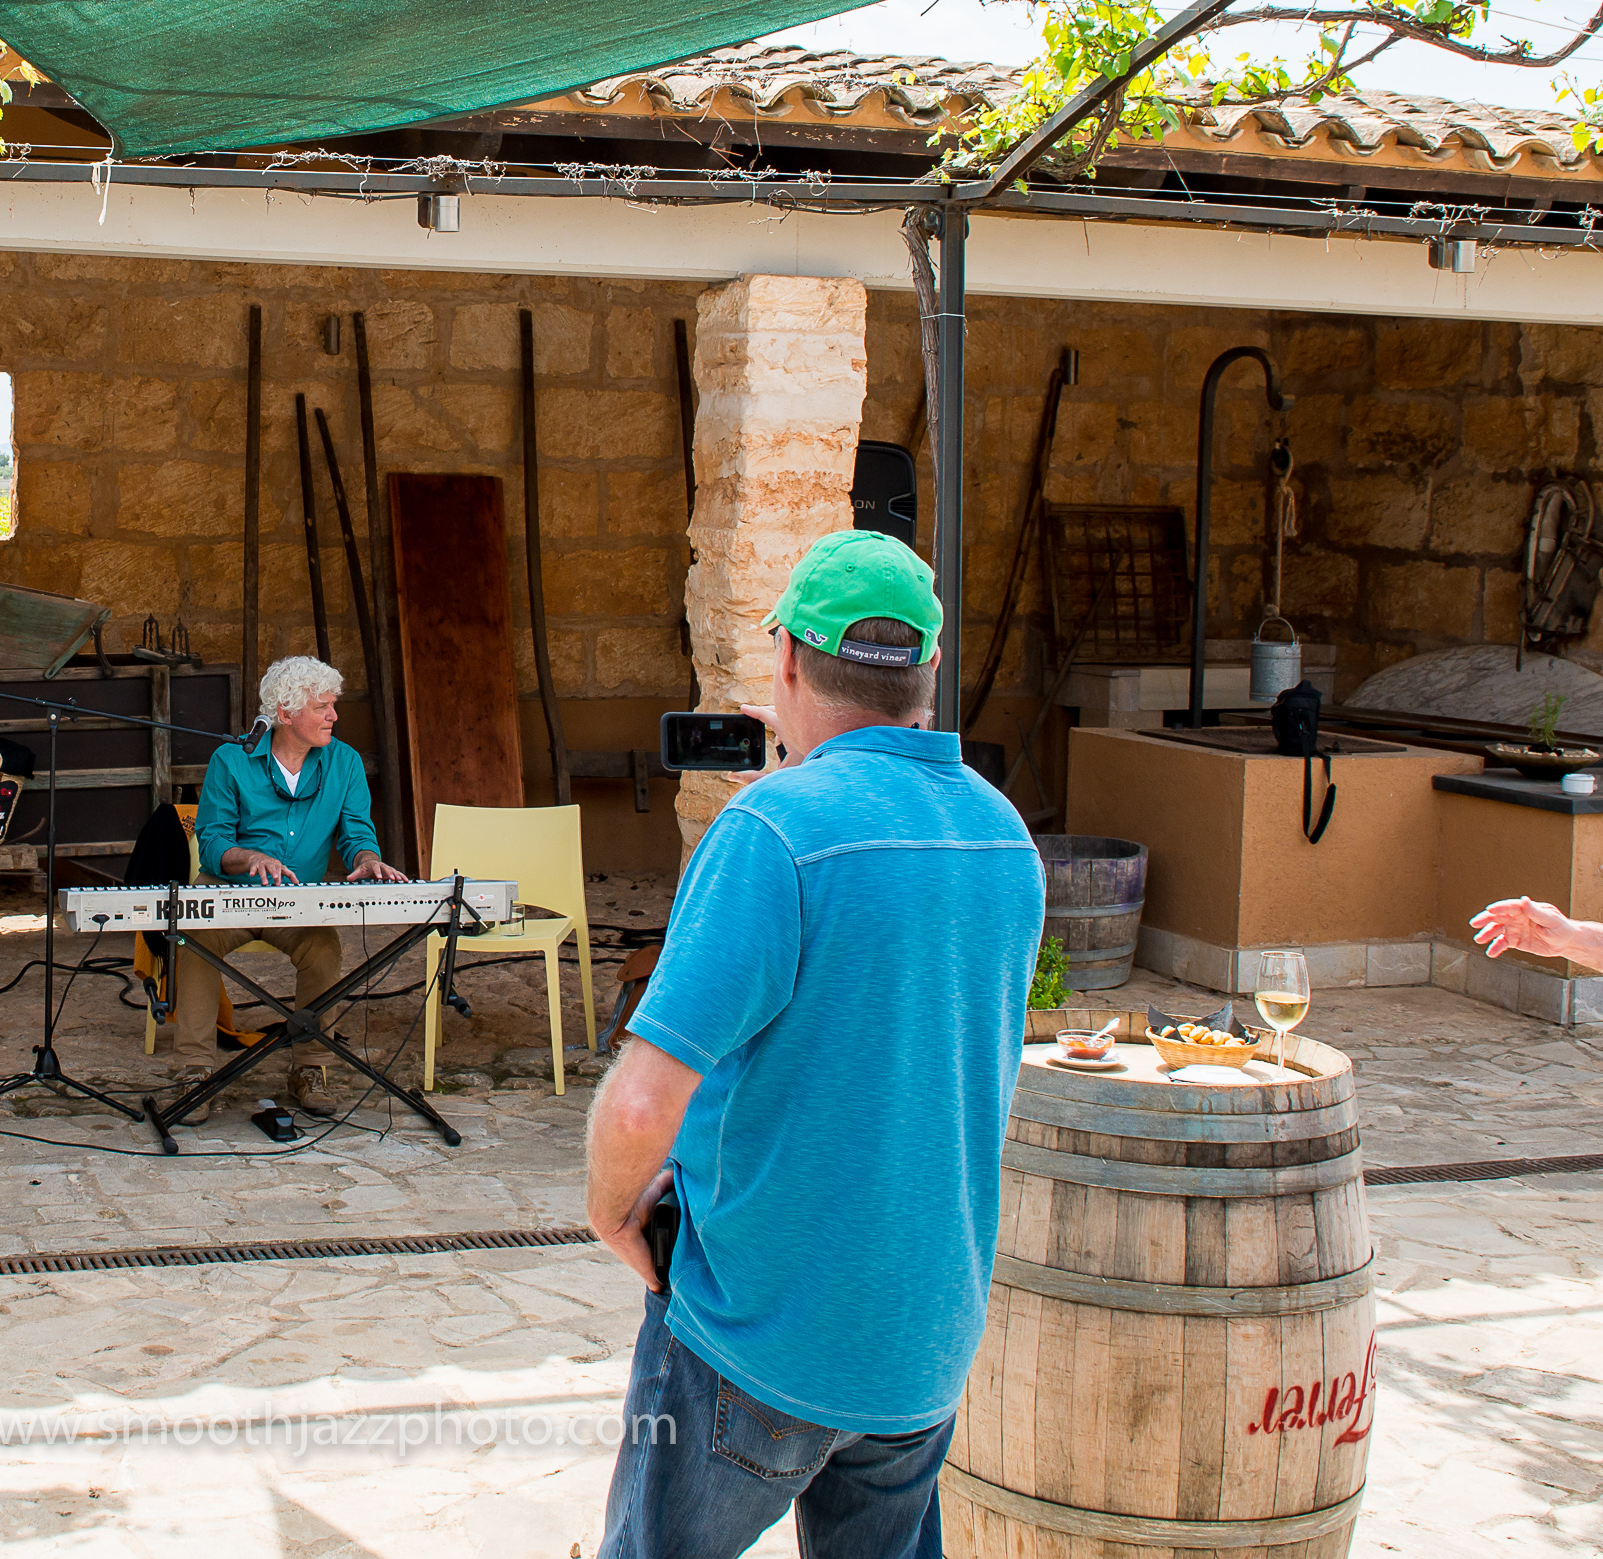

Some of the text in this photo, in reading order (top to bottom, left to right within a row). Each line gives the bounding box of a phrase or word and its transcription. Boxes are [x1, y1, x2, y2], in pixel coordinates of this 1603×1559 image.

[841, 646, 879, 659] vineyard
[156, 899, 215, 920] KORG
[222, 897, 296, 910] TRITON pro
[1248, 1329, 1375, 1449] Ferrer
